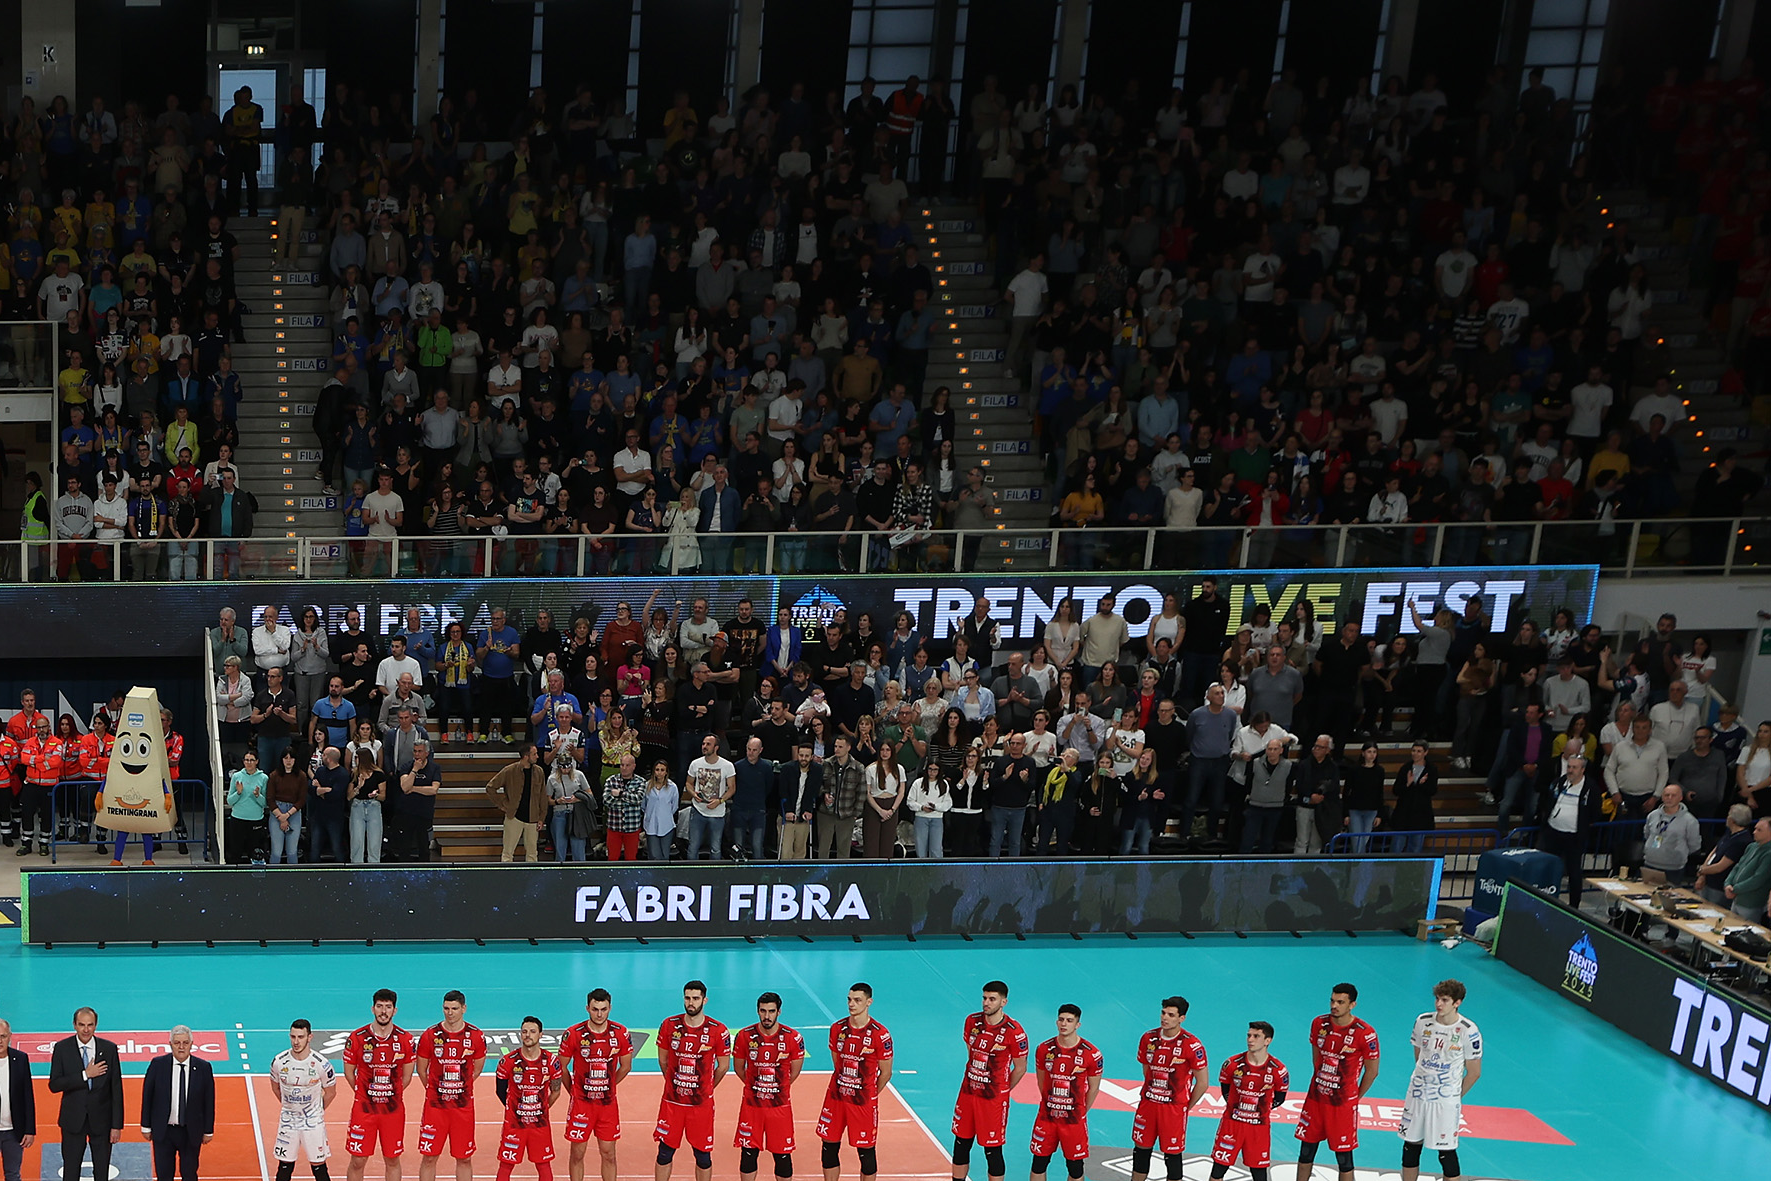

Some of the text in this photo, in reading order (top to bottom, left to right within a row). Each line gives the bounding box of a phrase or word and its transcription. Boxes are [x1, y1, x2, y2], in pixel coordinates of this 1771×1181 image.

[292, 316, 312, 326] FILA
[294, 360, 315, 370] FILA
[983, 396, 1005, 406] FILA
[995, 442, 1017, 452] FILA
[1006, 489, 1028, 500] FILA
[303, 498, 324, 508] FILA
[1192, 583, 1339, 635] IVE
[107, 806, 158, 819] TRENTINGRANA
[575, 883, 869, 923] FABRI FIBRA
[1567, 950, 1599, 974] TRENTO
[1564, 962, 1597, 986] LIVE FEST
[1562, 973, 1595, 998] 2025
[685, 1041, 694, 1052] 12
[979, 1039, 987, 1050] 15
[1434, 1038, 1444, 1050] 14
[1670, 977, 1771, 1106] TRE
[448, 1047, 457, 1057] 18
[596, 1047, 602, 1057] 4
[849, 1043, 855, 1053] 11
[380, 1052, 386, 1062] 3
[764, 1050, 770, 1061] 9
[1157, 1054, 1167, 1064] 21
[1059, 1063, 1066, 1073] 8
[529, 1074, 535, 1084] 5
[1248, 1080, 1254, 1090] 6
